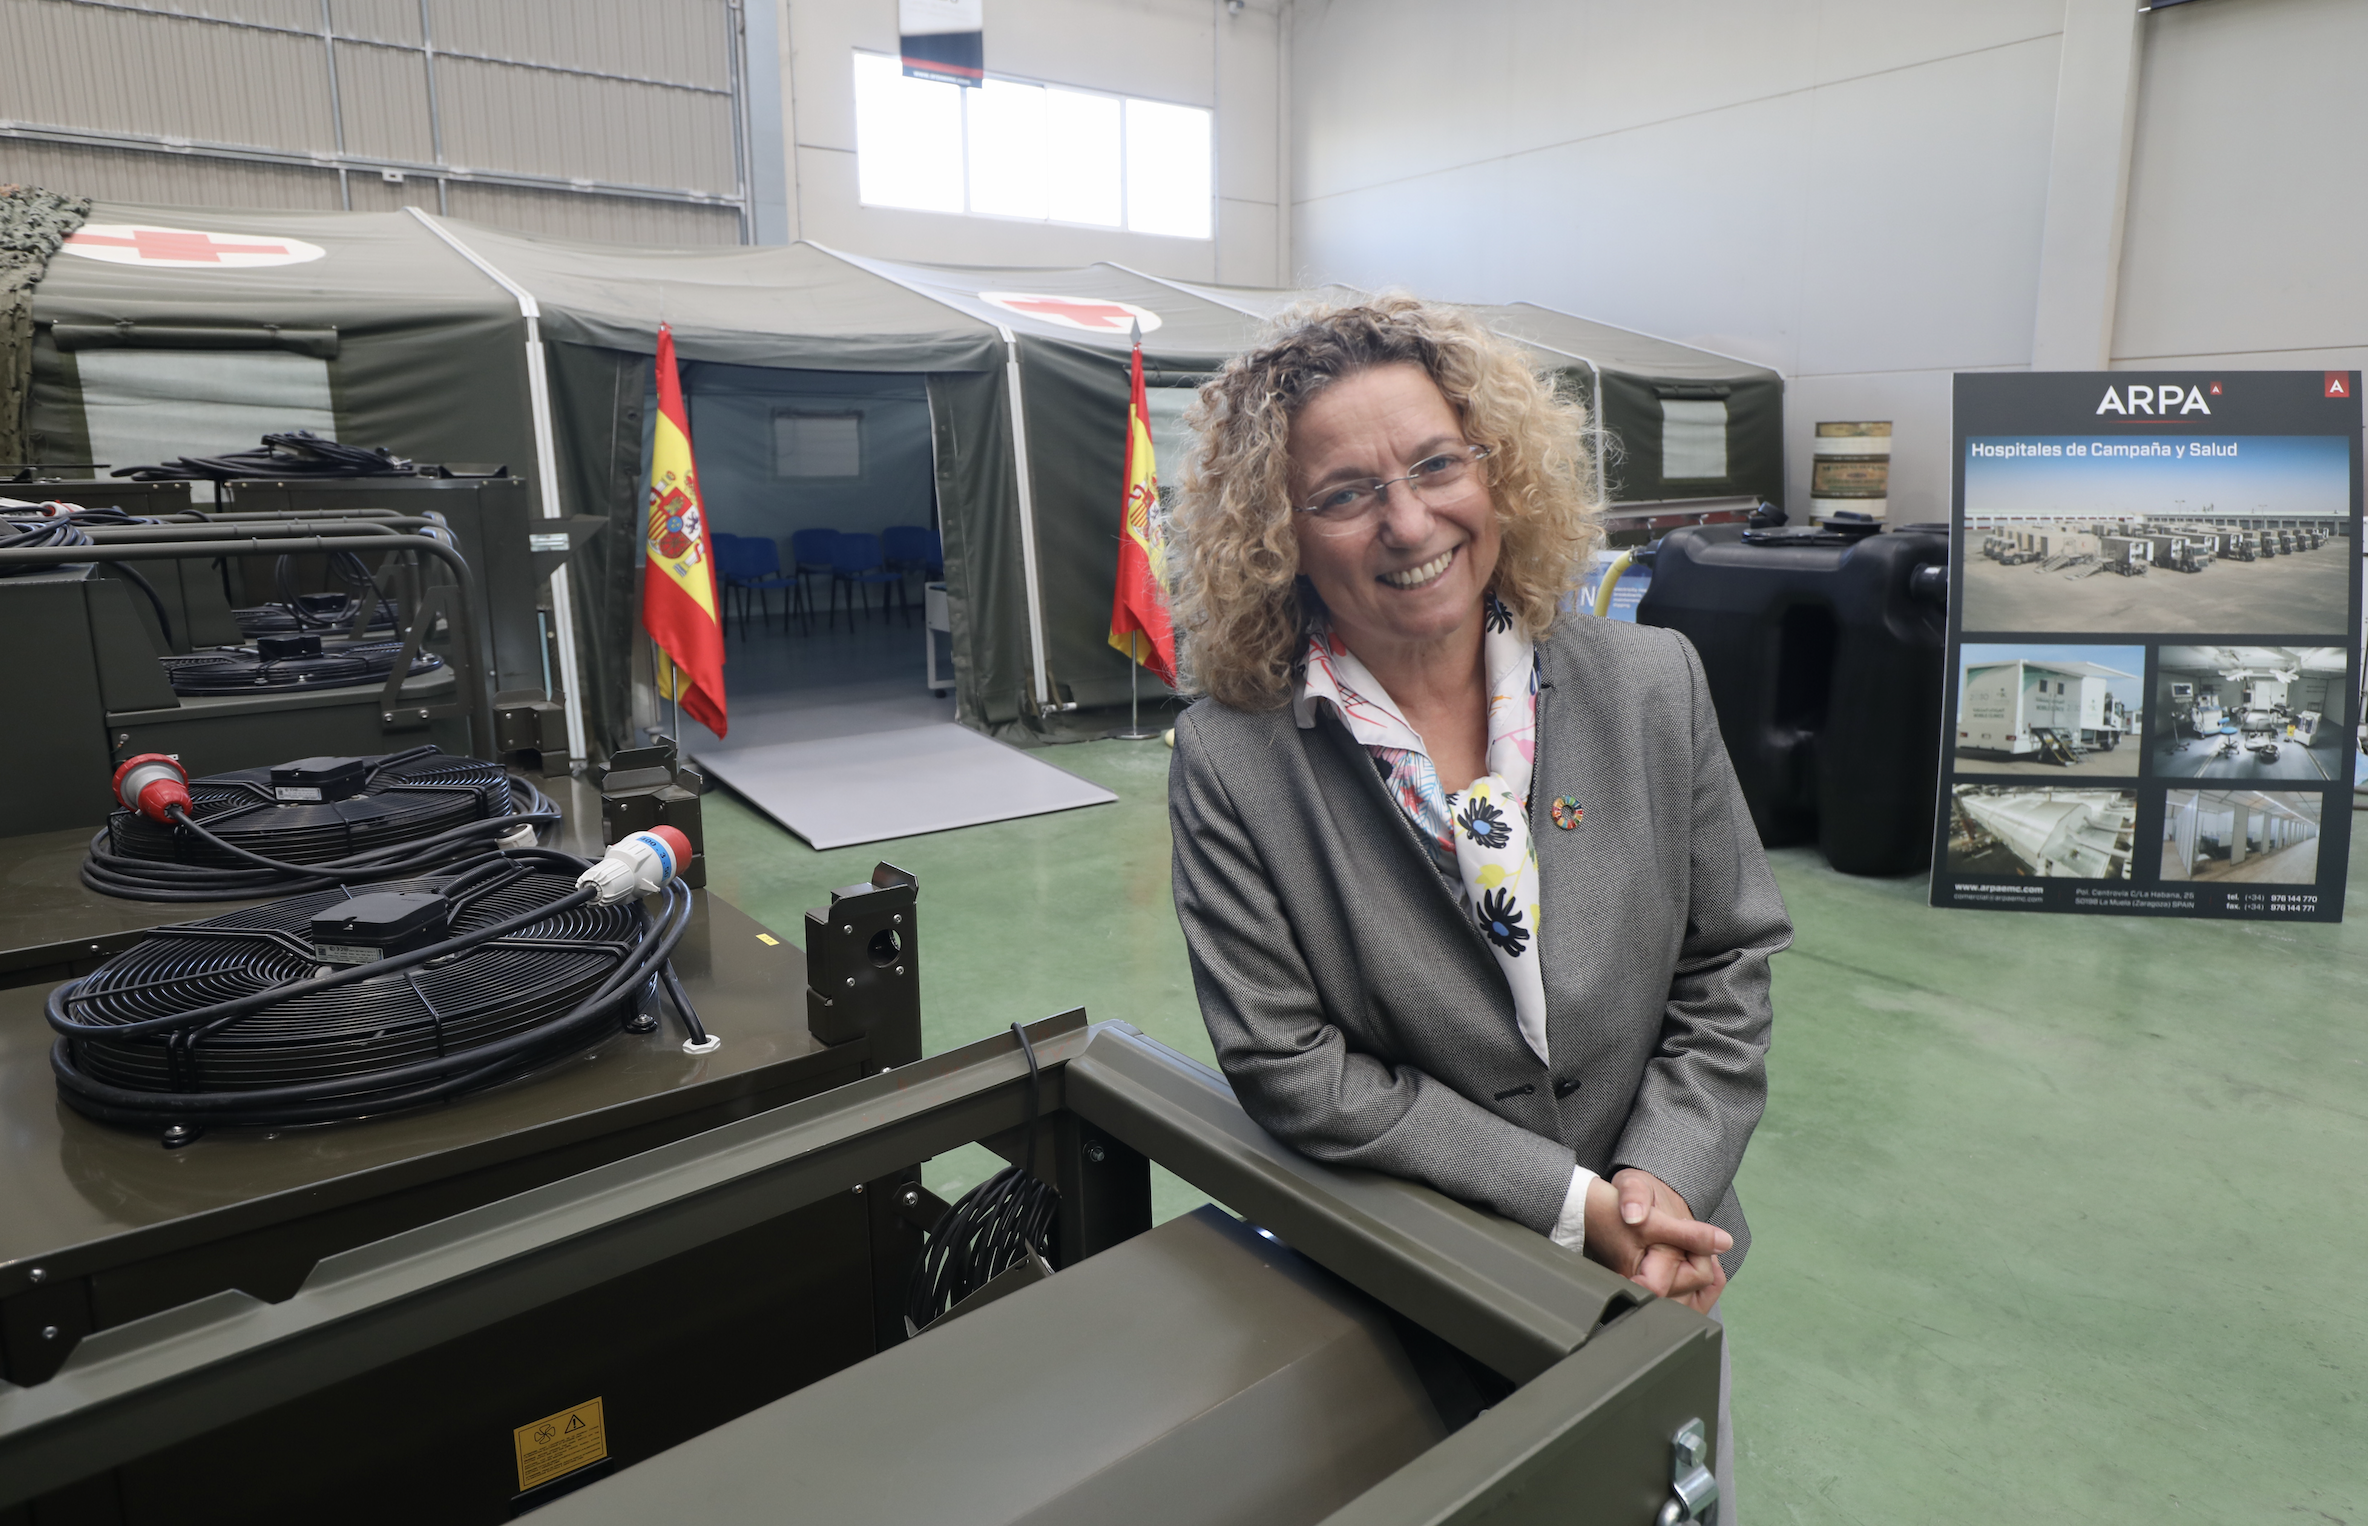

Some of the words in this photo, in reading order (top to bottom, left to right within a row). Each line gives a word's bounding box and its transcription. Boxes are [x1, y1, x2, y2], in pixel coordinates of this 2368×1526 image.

[2329, 380, 2344, 394] A
[2096, 384, 2212, 415] ARPA
[1971, 442, 2062, 459] Hospitales
[2066, 442, 2087, 457] de
[2091, 442, 2172, 459] Campaña
[2175, 446, 2186, 460] y
[2189, 442, 2238, 457] Salud
[1954, 883, 2044, 894] www.arpaemc.com
[2075, 888, 2089, 896] Pol.
[2227, 893, 2239, 901] tel.
[2244, 894, 2265, 902] (+34)
[2270, 894, 2286, 902] 976
[2302, 895, 2318, 903] 770
[2132, 899, 2171, 908] (Zaragoza)
[2172, 901, 2195, 909] SPAIN
[2226, 902, 2241, 910] fax.
[2244, 903, 2265, 911] (+34)
[2270, 903, 2286, 911] 976
[2287, 904, 2301, 912] 144
[2302, 904, 2315, 912] 771
